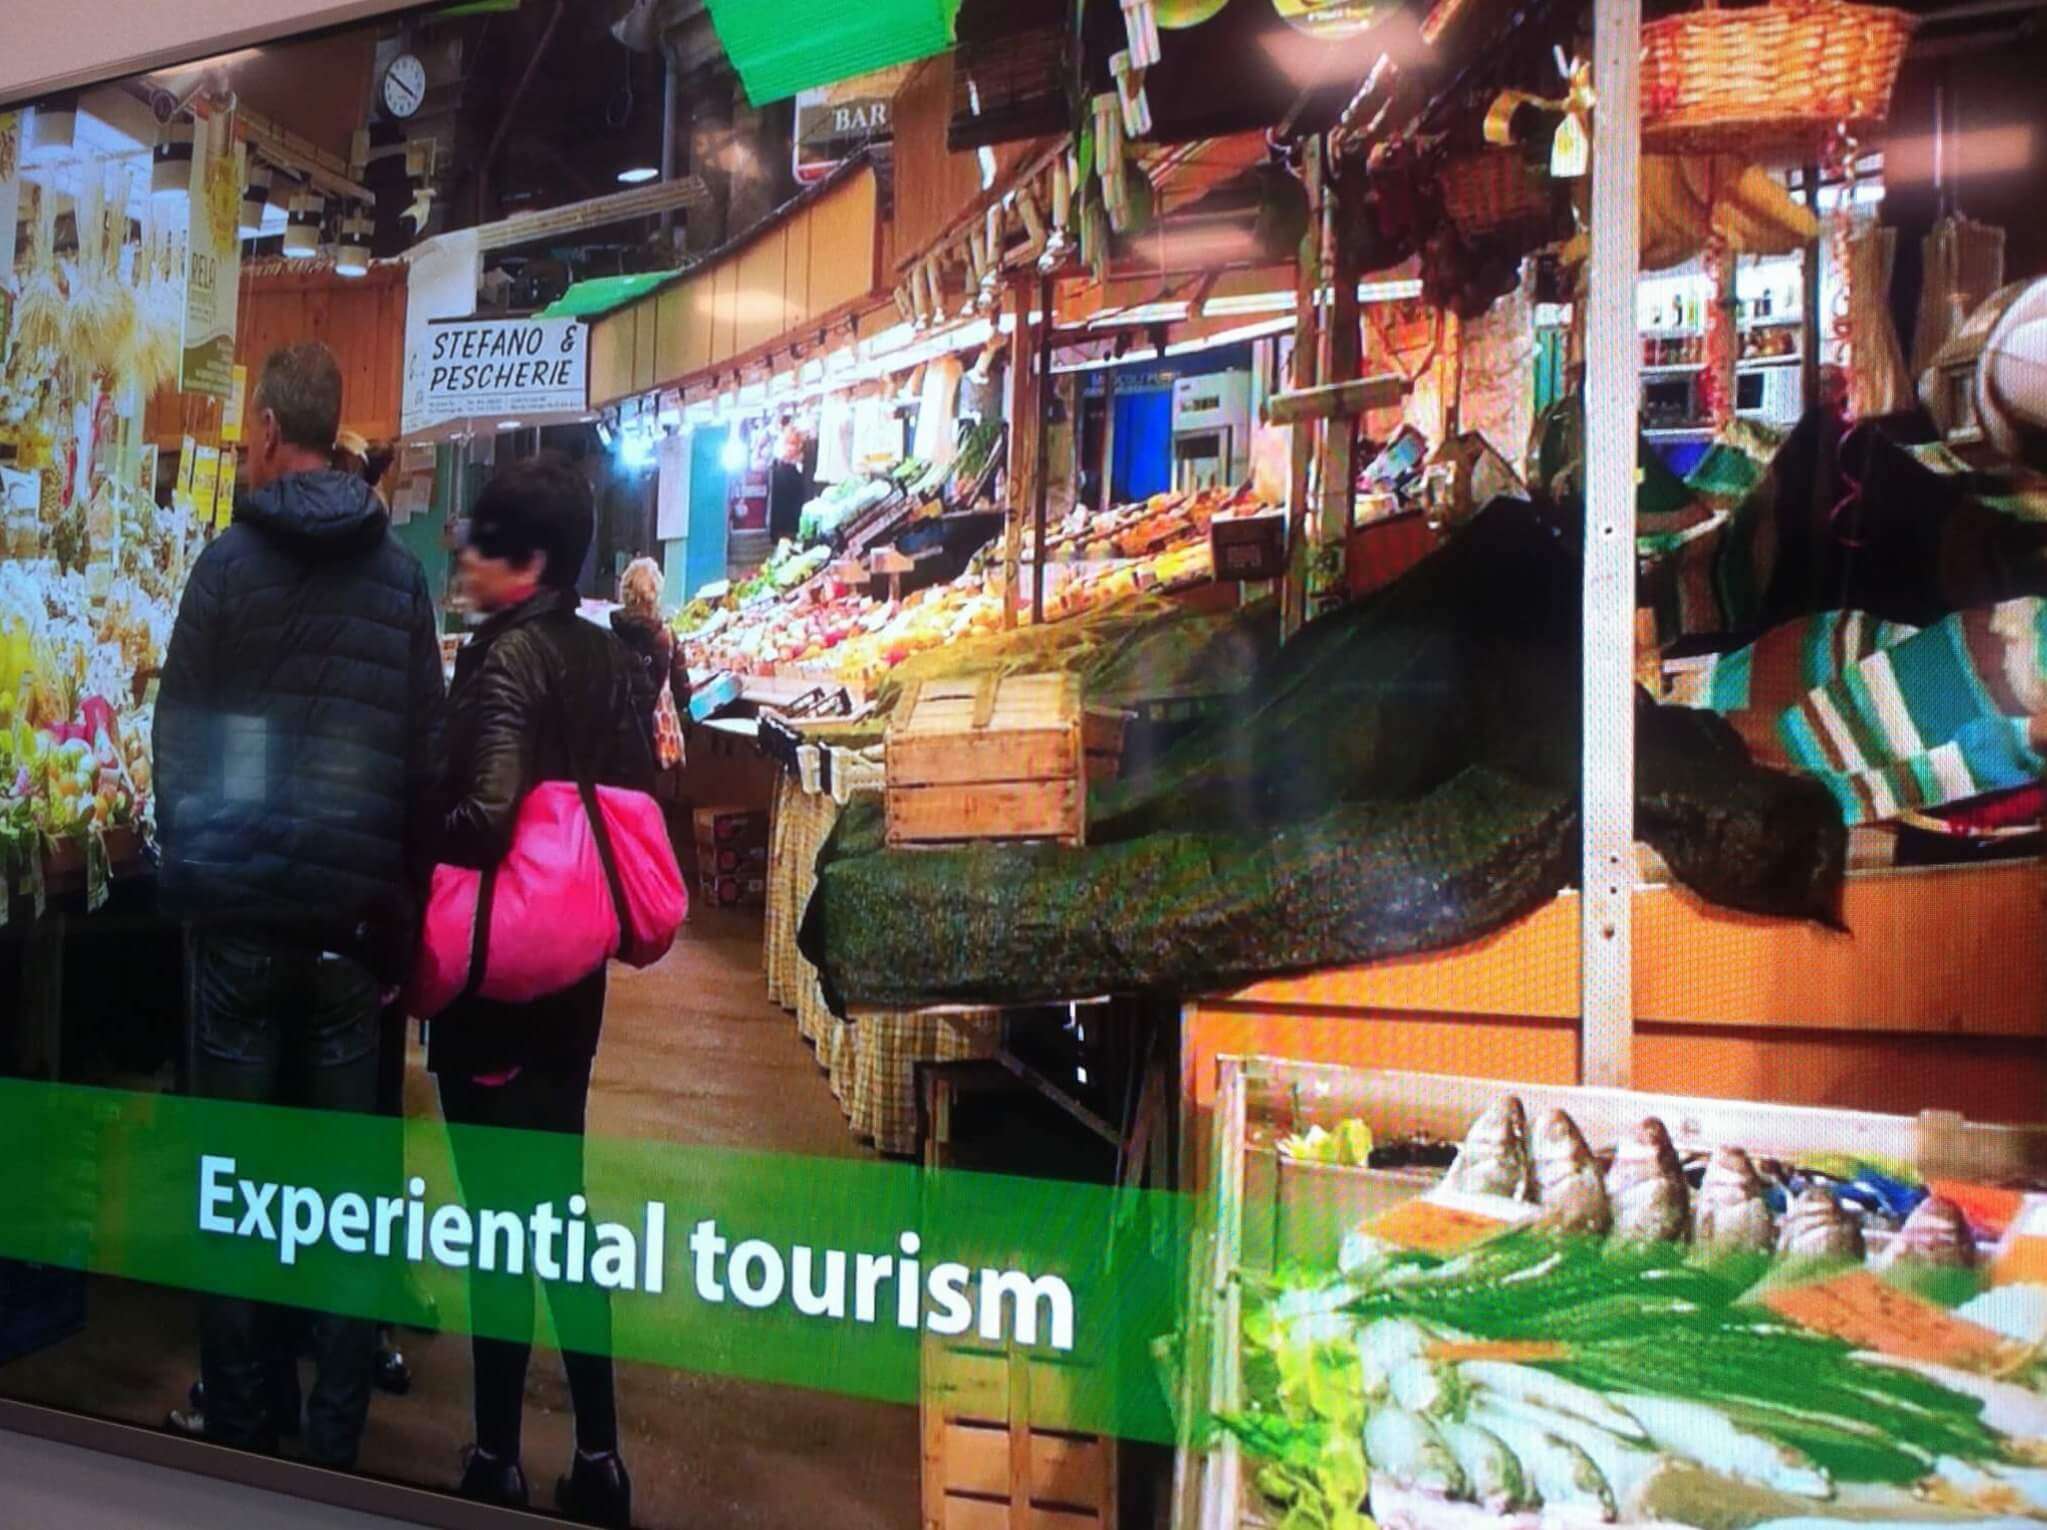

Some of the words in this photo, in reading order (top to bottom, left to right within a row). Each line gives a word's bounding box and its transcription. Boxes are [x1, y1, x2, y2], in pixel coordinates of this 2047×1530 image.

[835, 103, 887, 132] BAR
[432, 327, 544, 361] STEFANO
[429, 359, 574, 392] PESCHERIE
[198, 1154, 667, 1294] Experiential
[689, 1218, 1075, 1352] tourism
